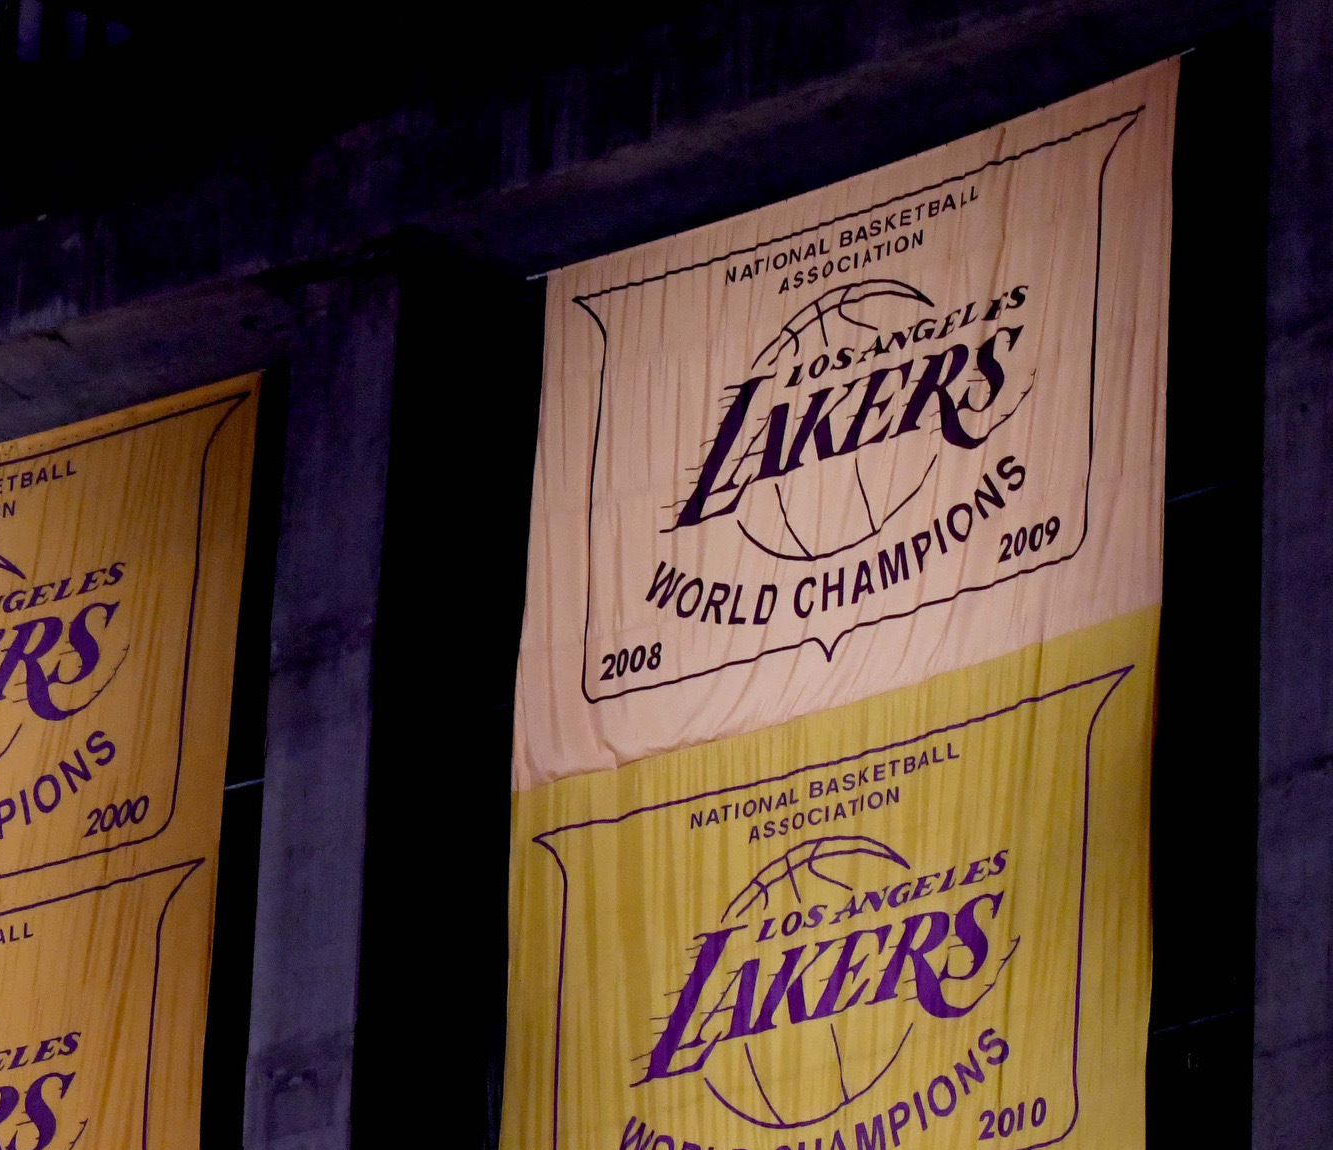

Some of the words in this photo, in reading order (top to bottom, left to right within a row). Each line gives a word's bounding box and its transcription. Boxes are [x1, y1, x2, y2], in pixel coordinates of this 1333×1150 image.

[725, 238, 830, 285] NATIONAL
[840, 187, 979, 248] BASKETBALL
[779, 231, 924, 294] ASSOCIATION
[785, 345, 853, 387] LOS
[858, 285, 1029, 360] ANGELES
[659, 326, 1024, 533] LAKERS
[645, 561, 778, 625] WORLD
[794, 455, 1027, 618] CHAMPIONS
[999, 516, 1061, 563] 2009
[601, 643, 662, 681] 2008
[83, 796, 149, 837] 2000
[690, 789, 800, 829] NATIONAL
[810, 743, 960, 799] BASKETBALL
[749, 787, 901, 843] ASSOCIATION
[756, 903, 824, 941] LOS
[832, 850, 1009, 922] ANGELES
[630, 891, 1005, 1087] LAKERS
[978, 1097, 1047, 1141] 2010
